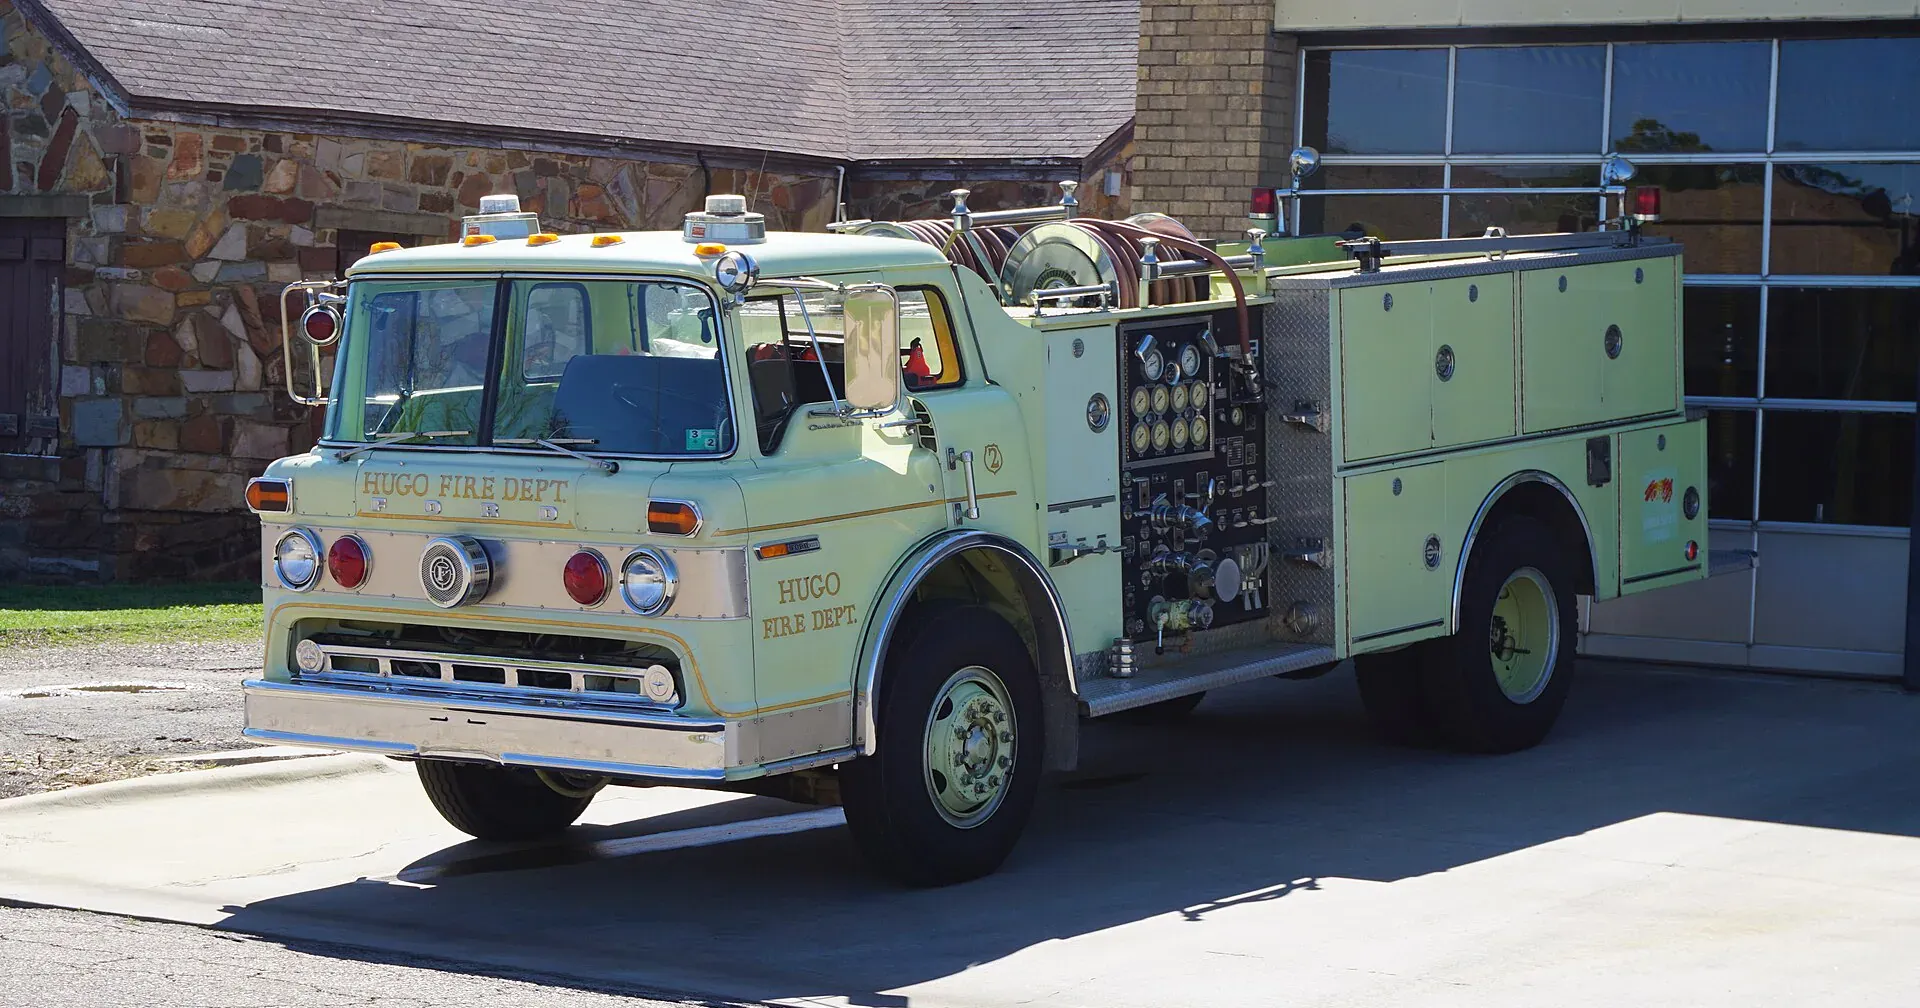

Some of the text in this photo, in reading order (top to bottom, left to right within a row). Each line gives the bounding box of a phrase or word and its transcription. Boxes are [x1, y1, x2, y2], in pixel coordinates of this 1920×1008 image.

[691, 430, 699, 438] 3
[707, 438, 714, 446] 2
[988, 447, 1000, 468] 2
[362, 471, 569, 503] HUGO FIRE DEPT.
[372, 497, 558, 521] FORD
[777, 571, 841, 604] HUGO
[762, 604, 858, 640] FIRE DEPT.
